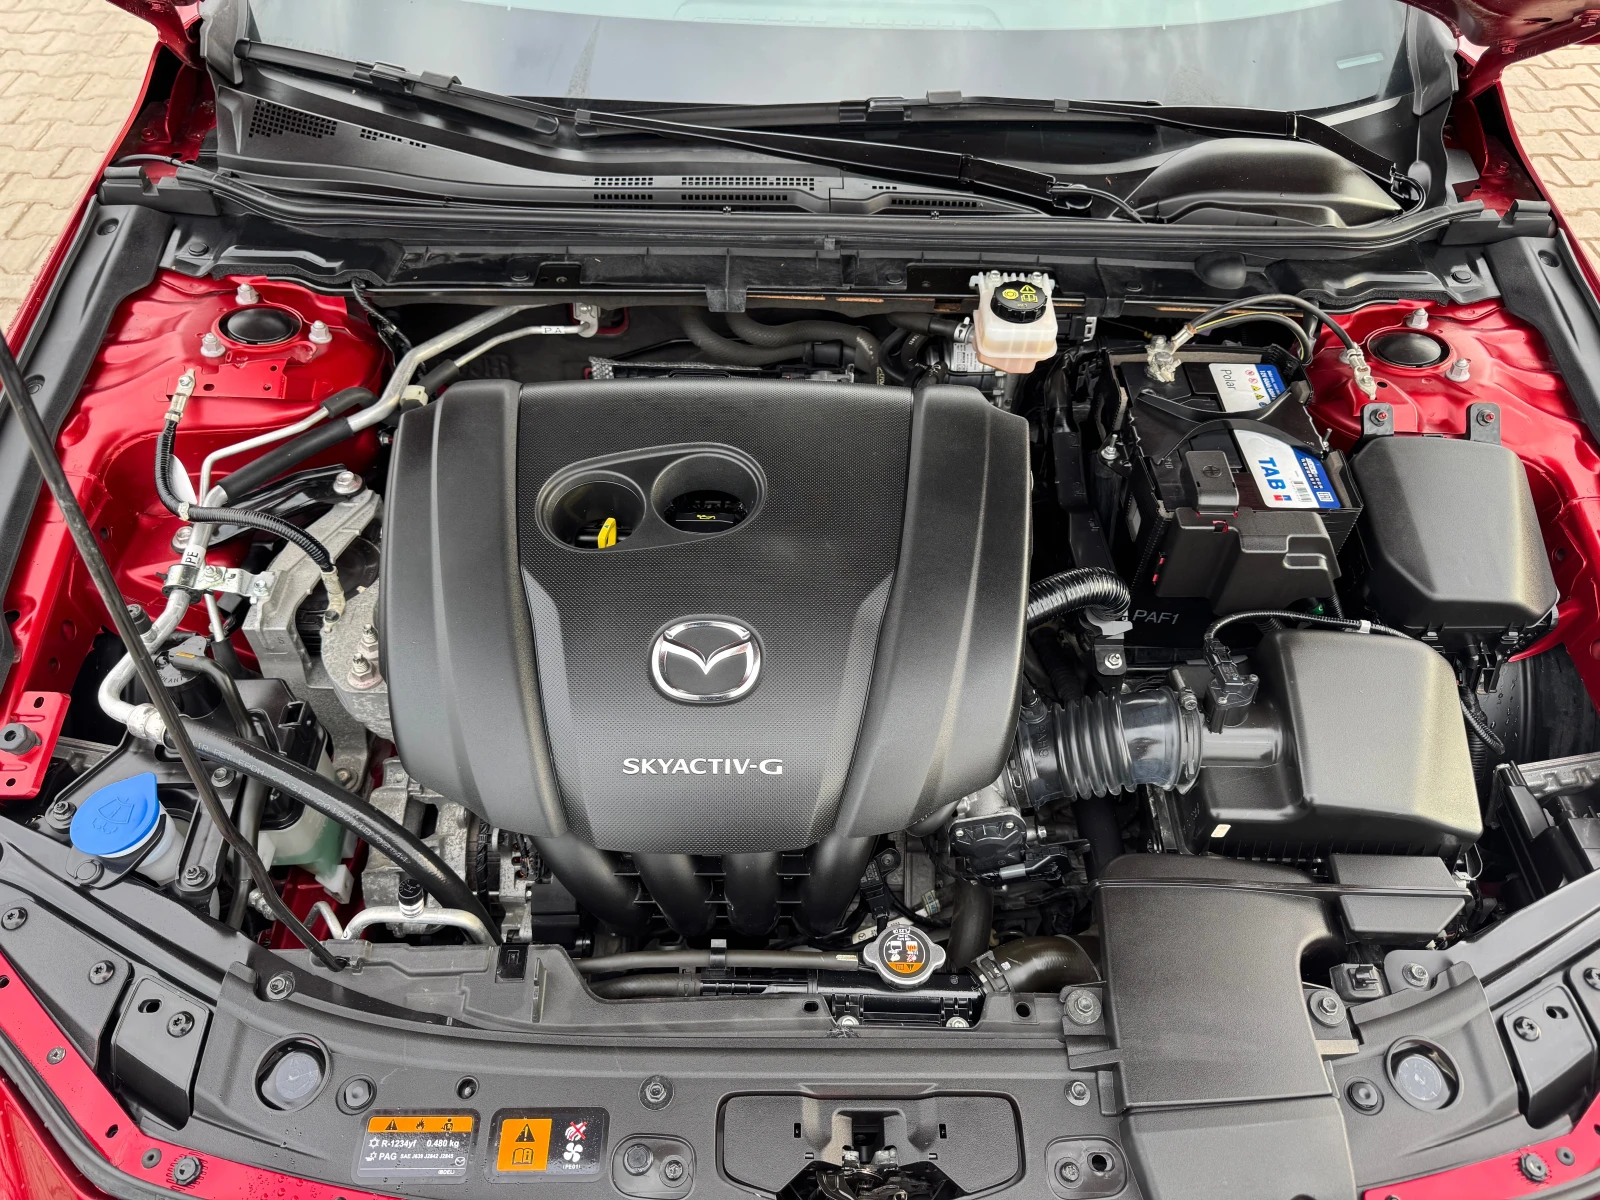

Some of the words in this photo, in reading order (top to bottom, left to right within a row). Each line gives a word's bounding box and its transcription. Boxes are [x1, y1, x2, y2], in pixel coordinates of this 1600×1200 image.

[1220, 369, 1237, 391] Polar
[1258, 457, 1287, 490] TAB
[185, 552, 199, 564] PE
[1132, 609, 1179, 625] PAF1
[622, 758, 783, 775] SKYACTIV-G
[381, 1139, 417, 1149] R-1234yf
[426, 1139, 448, 1148] 0.480
[449, 1139, 460, 1149] kg
[378, 1152, 397, 1161] PAG
